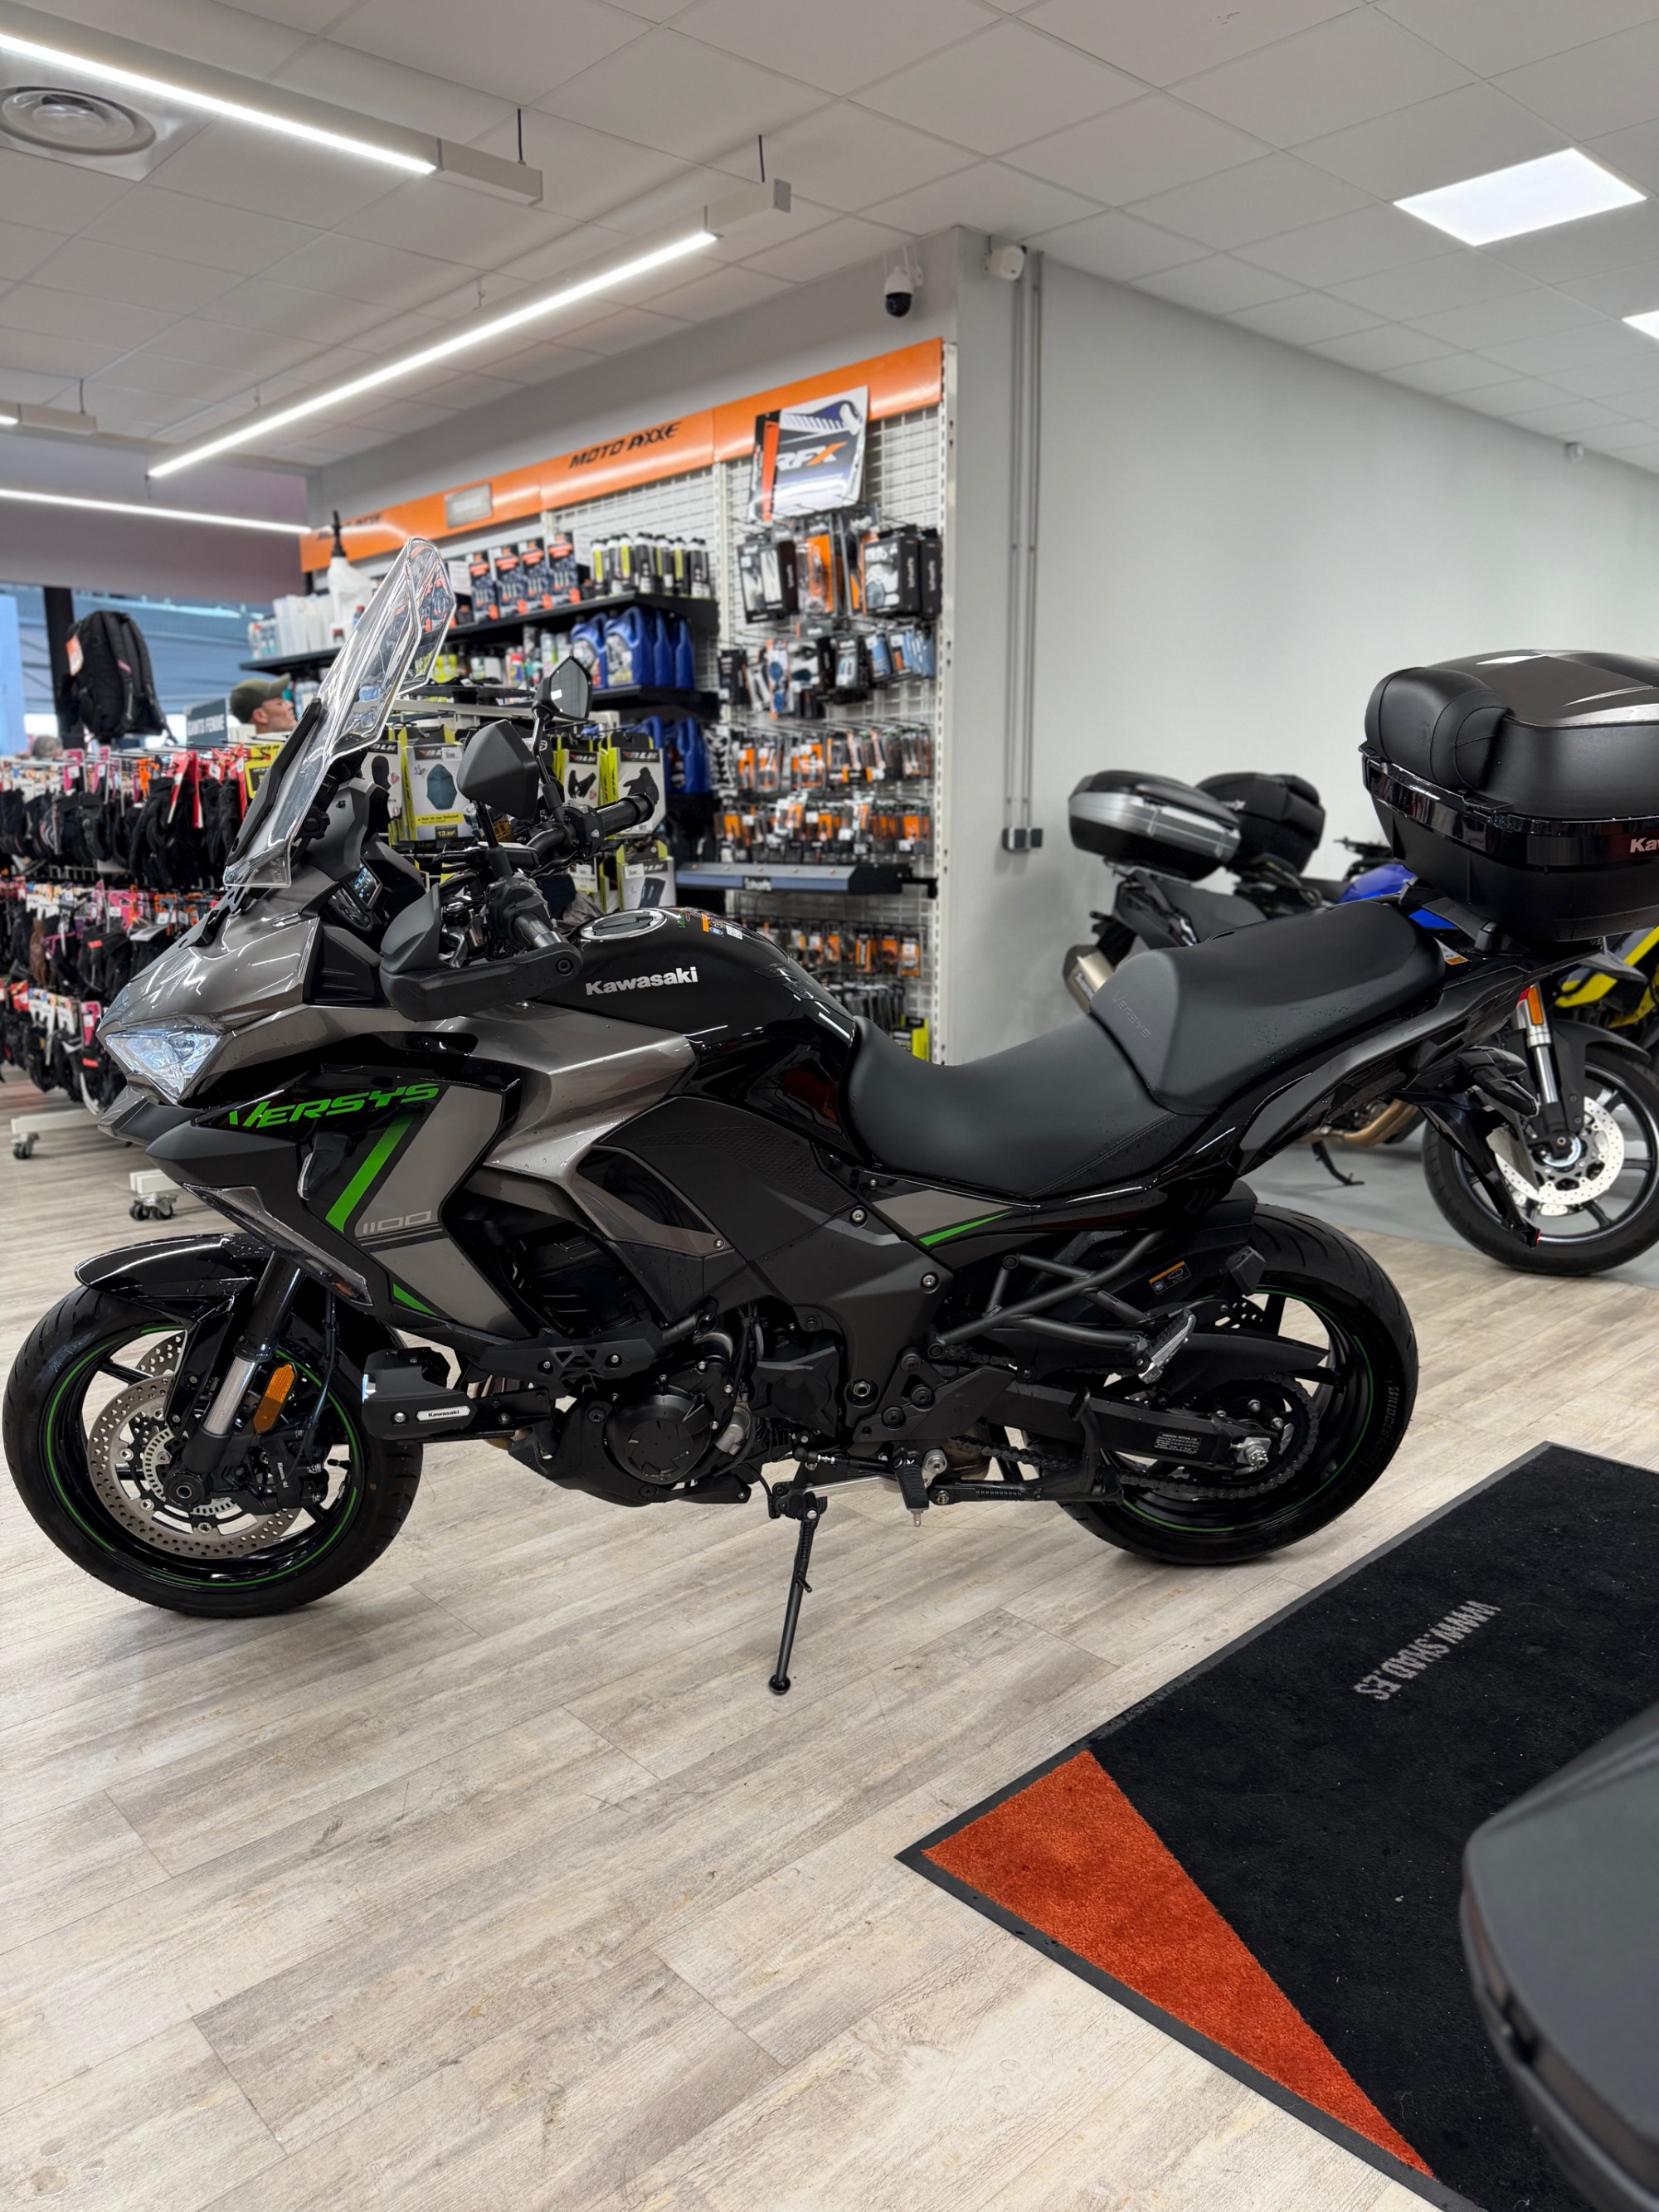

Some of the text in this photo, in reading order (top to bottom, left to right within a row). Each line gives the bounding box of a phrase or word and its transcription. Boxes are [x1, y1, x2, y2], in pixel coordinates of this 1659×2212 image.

[569, 421, 682, 469] MOTO AXXE
[586, 965, 698, 995] Kawasaki
[229, 1083, 440, 1128] VERSYS
[362, 1210, 431, 1234] 1100
